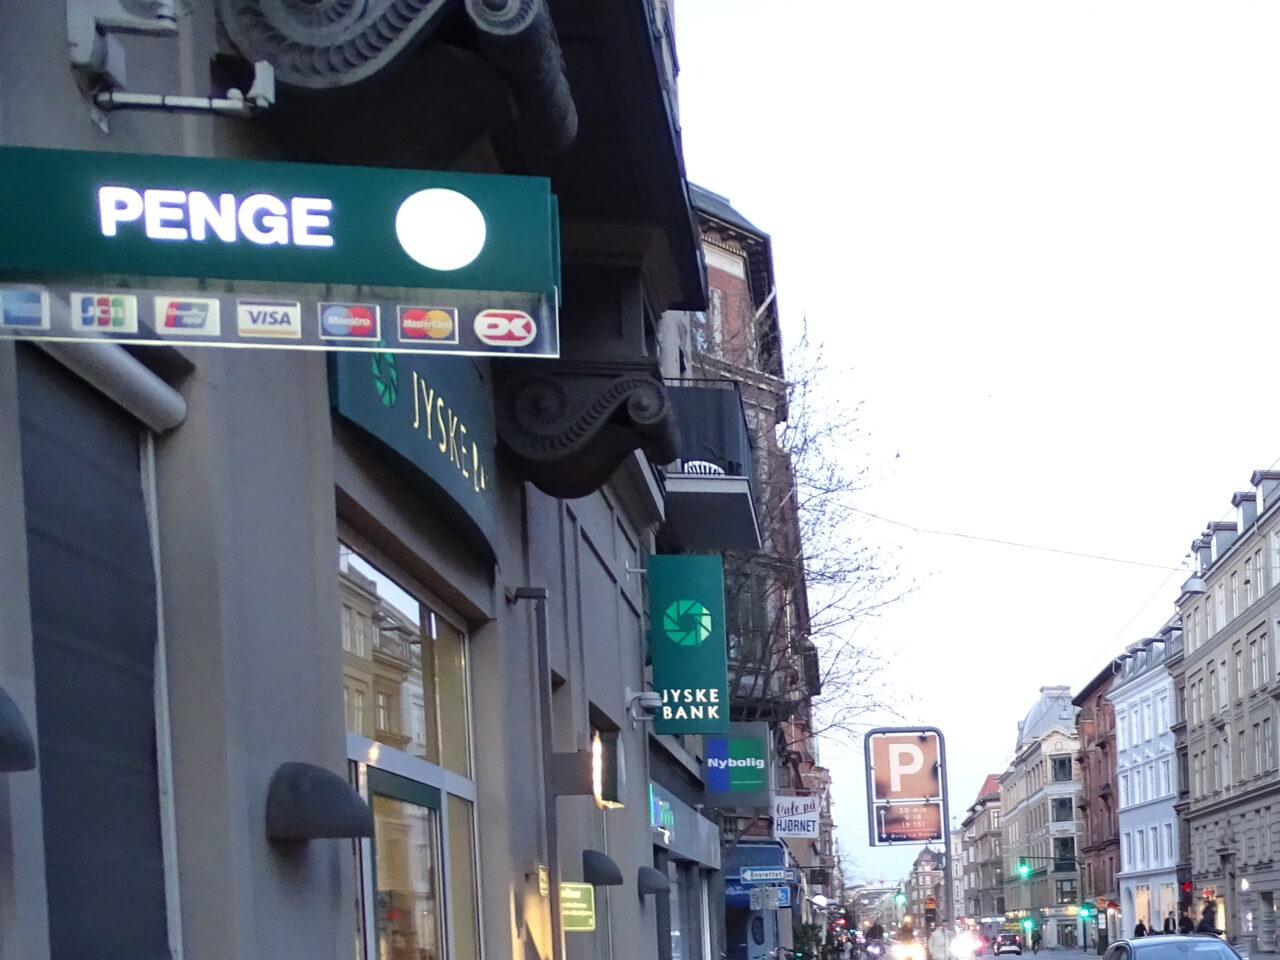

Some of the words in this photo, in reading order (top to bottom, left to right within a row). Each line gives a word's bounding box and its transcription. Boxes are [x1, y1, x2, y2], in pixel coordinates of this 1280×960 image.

[97, 185, 335, 248] PENGE
[247, 310, 292, 327] VISA
[327, 315, 371, 327] Maestro
[402, 318, 454, 331] MasterCard
[412, 370, 470, 479] JYSKE
[662, 688, 720, 703] JYSKE
[662, 705, 720, 720] BANK
[707, 756, 765, 770] Nybolig
[888, 743, 925, 792] P
[775, 818, 817, 833] HJØRNET
[750, 870, 783, 878] Ensrettet
